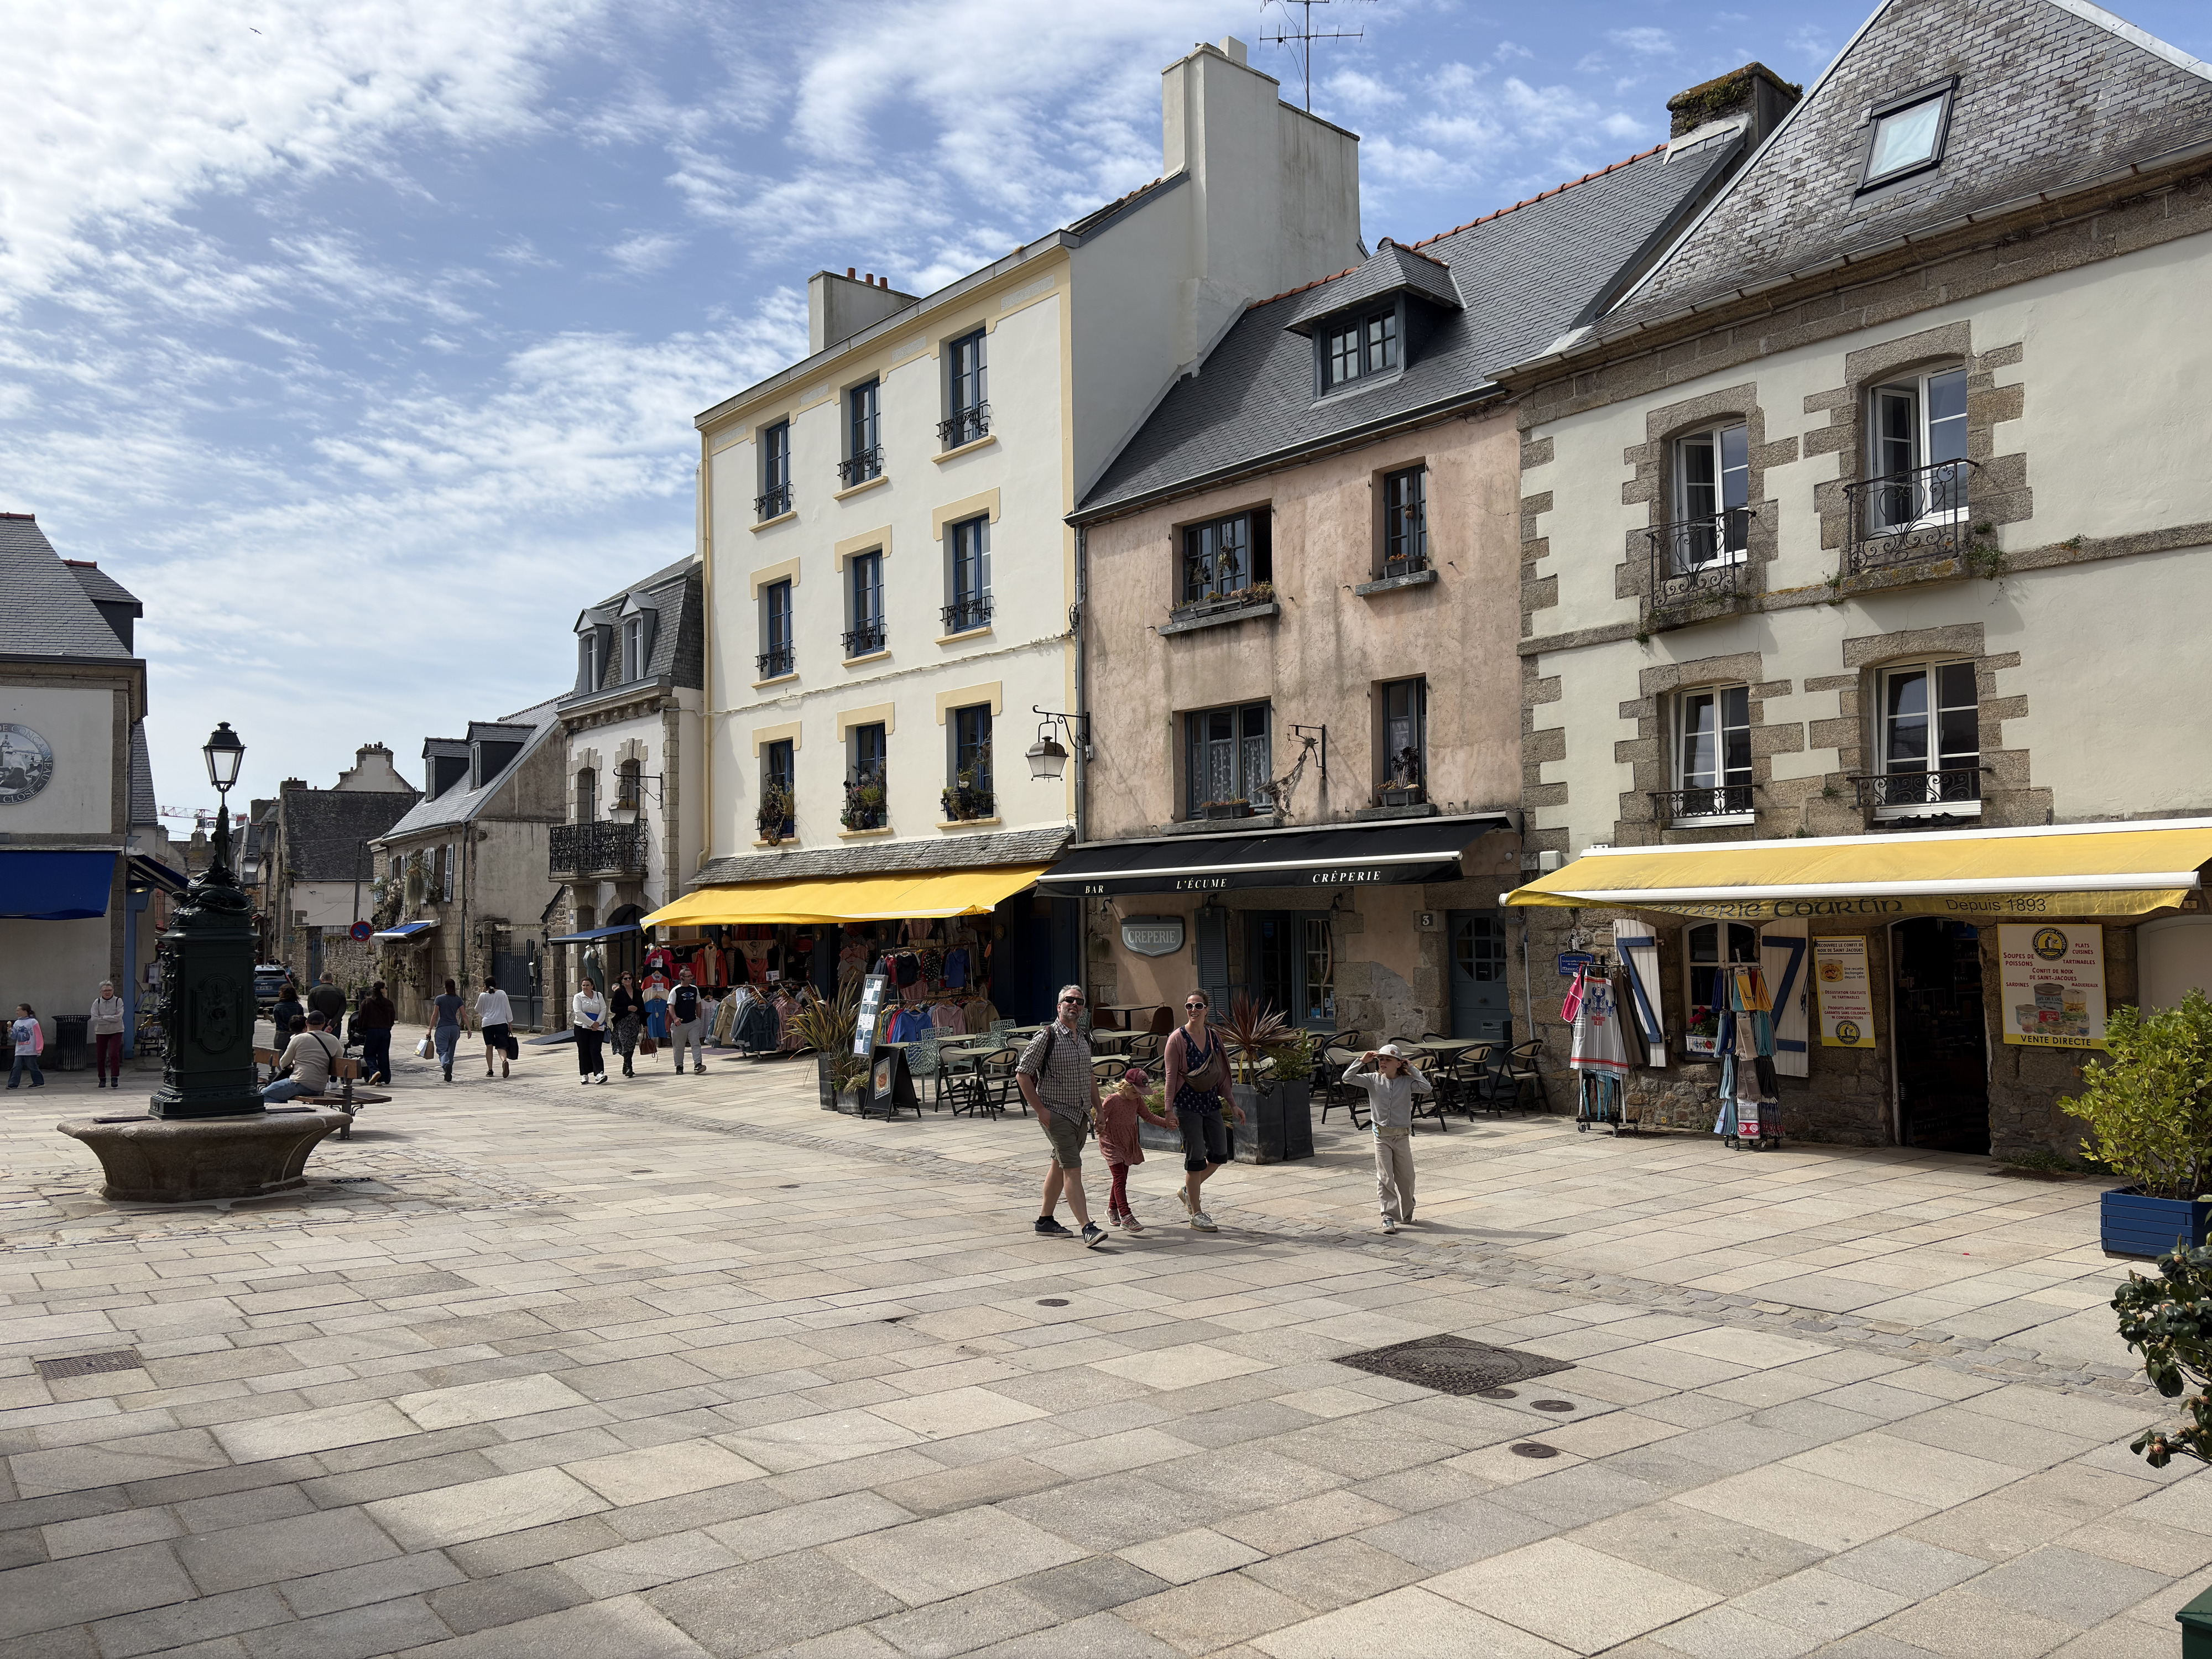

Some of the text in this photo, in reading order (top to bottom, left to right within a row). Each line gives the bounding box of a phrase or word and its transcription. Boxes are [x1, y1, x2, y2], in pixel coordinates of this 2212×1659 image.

[11, 725, 53, 781] CONCARNEAU
[3, 787, 37, 803] CLOSE
[1085, 870, 1381, 894] BAR L'ÉCUME CRÊPERIE
[1945, 898, 2046, 912] Depuis 1893
[1422, 915, 1430, 926] 3
[1128, 931, 1176, 943] CREPERIE
[2021, 1035, 2091, 1046] VENTE DIRECTE
